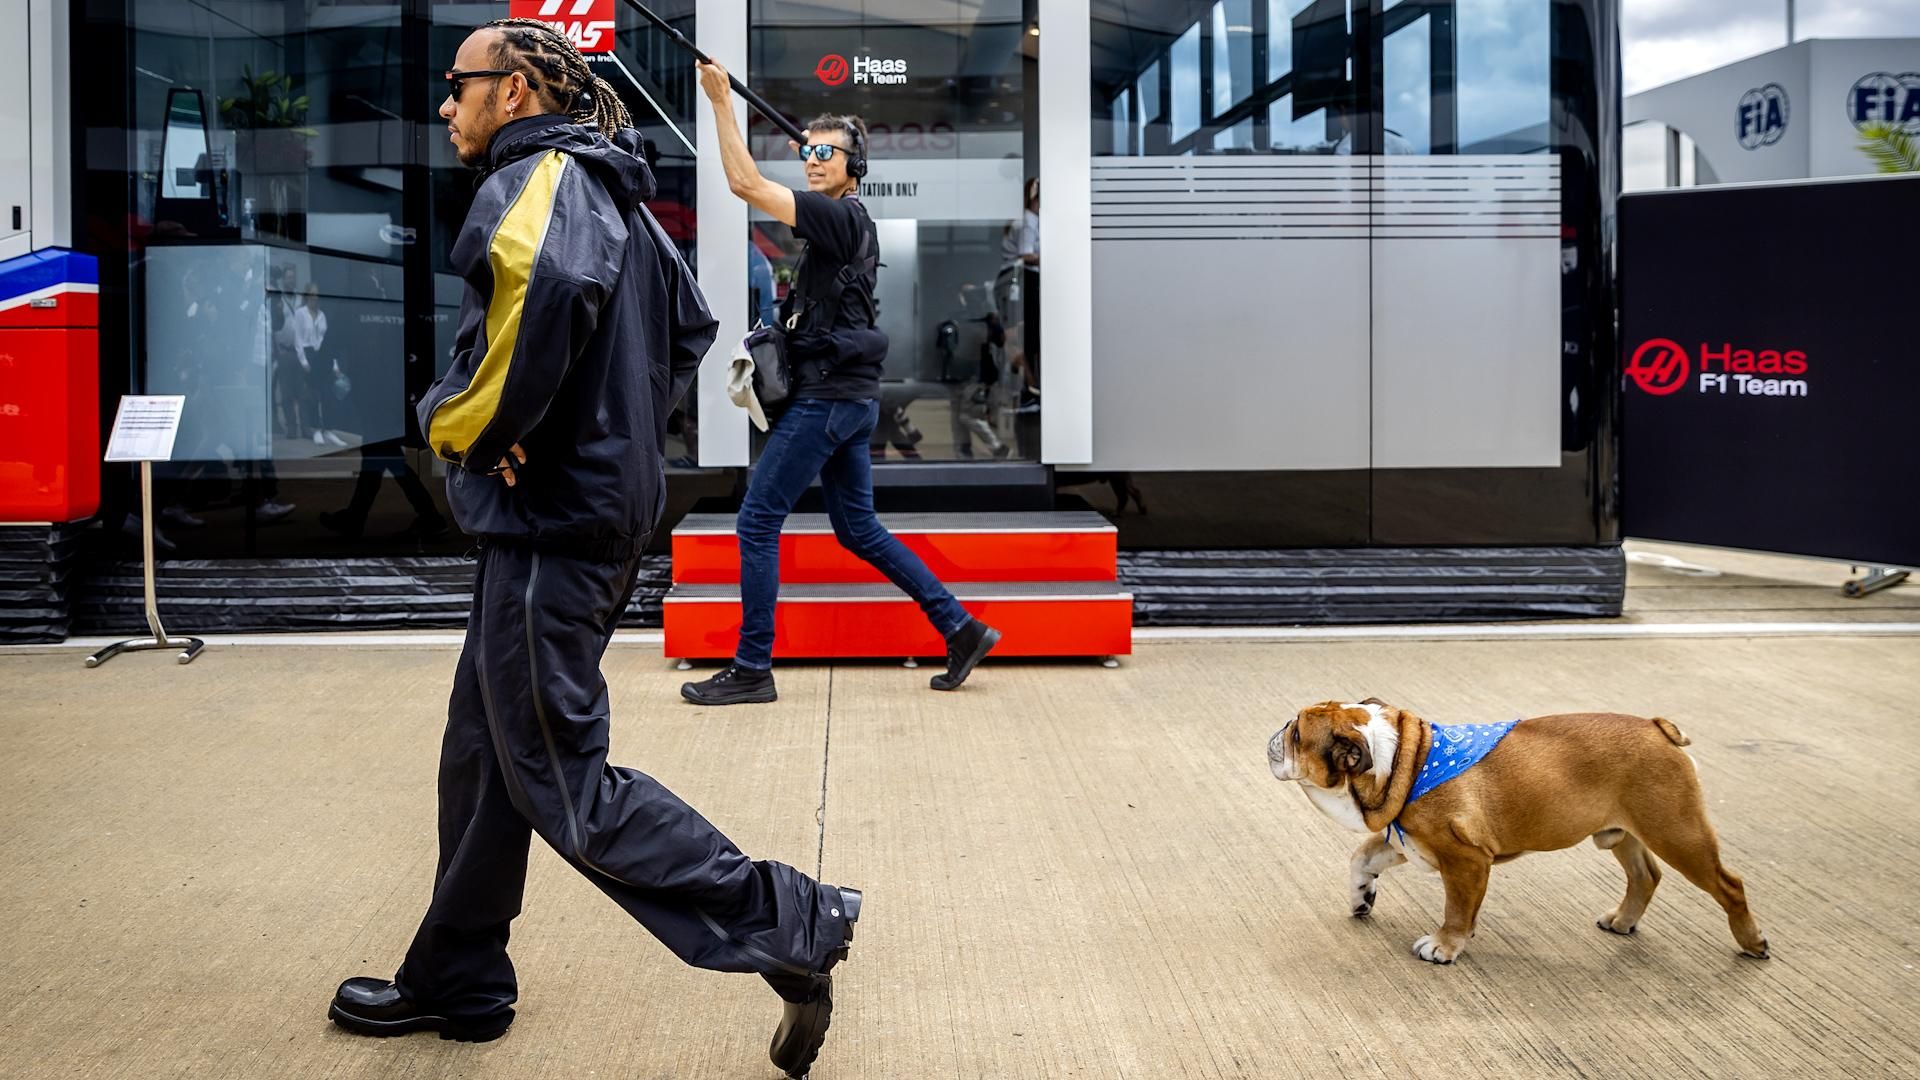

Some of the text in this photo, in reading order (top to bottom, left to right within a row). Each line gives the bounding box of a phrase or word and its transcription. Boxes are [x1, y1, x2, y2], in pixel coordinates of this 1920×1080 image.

[853, 56, 907, 73] Haas
[853, 73, 907, 84] F1 Team
[868, 122, 955, 151] aas
[859, 182, 918, 197] ITATION ONLY
[1700, 343, 1808, 374] Haas
[1699, 373, 1808, 397] F1 Team
